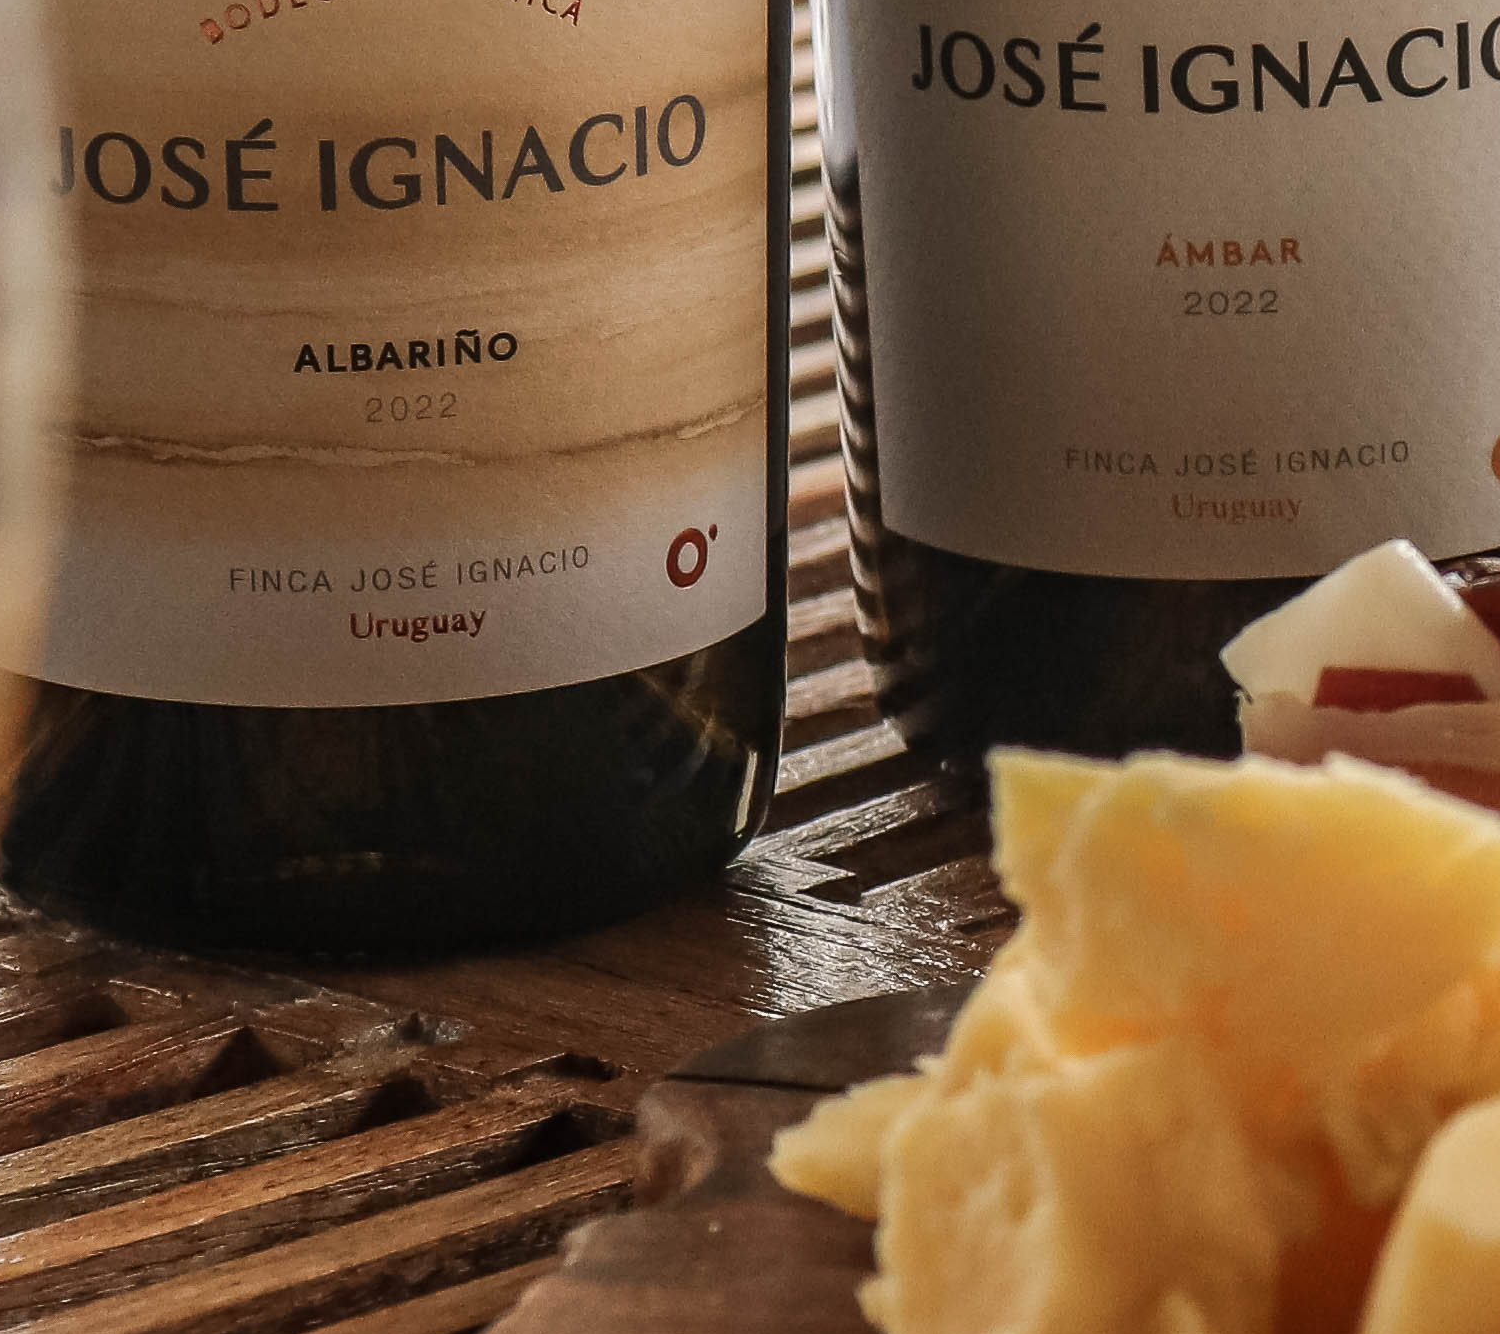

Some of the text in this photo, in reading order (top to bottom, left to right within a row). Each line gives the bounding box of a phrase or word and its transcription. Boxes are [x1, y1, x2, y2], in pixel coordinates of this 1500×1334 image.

[911, 22, 1108, 113] JOSÉ
[52, 94, 707, 211] JOSÉ IGNACIO
[1155, 233, 1304, 267] ÁMBAR
[1184, 289, 1279, 317] 2022
[293, 328, 518, 373] ALBARIÑO
[366, 392, 459, 424] 2022
[1066, 440, 1411, 478] FINCA JOSÉ IGNACIO
[1171, 492, 1304, 523] Uruguay
[228, 545, 590, 595] FINCA JOSÉ IGNACIO
[350, 609, 487, 644] Uruguay
